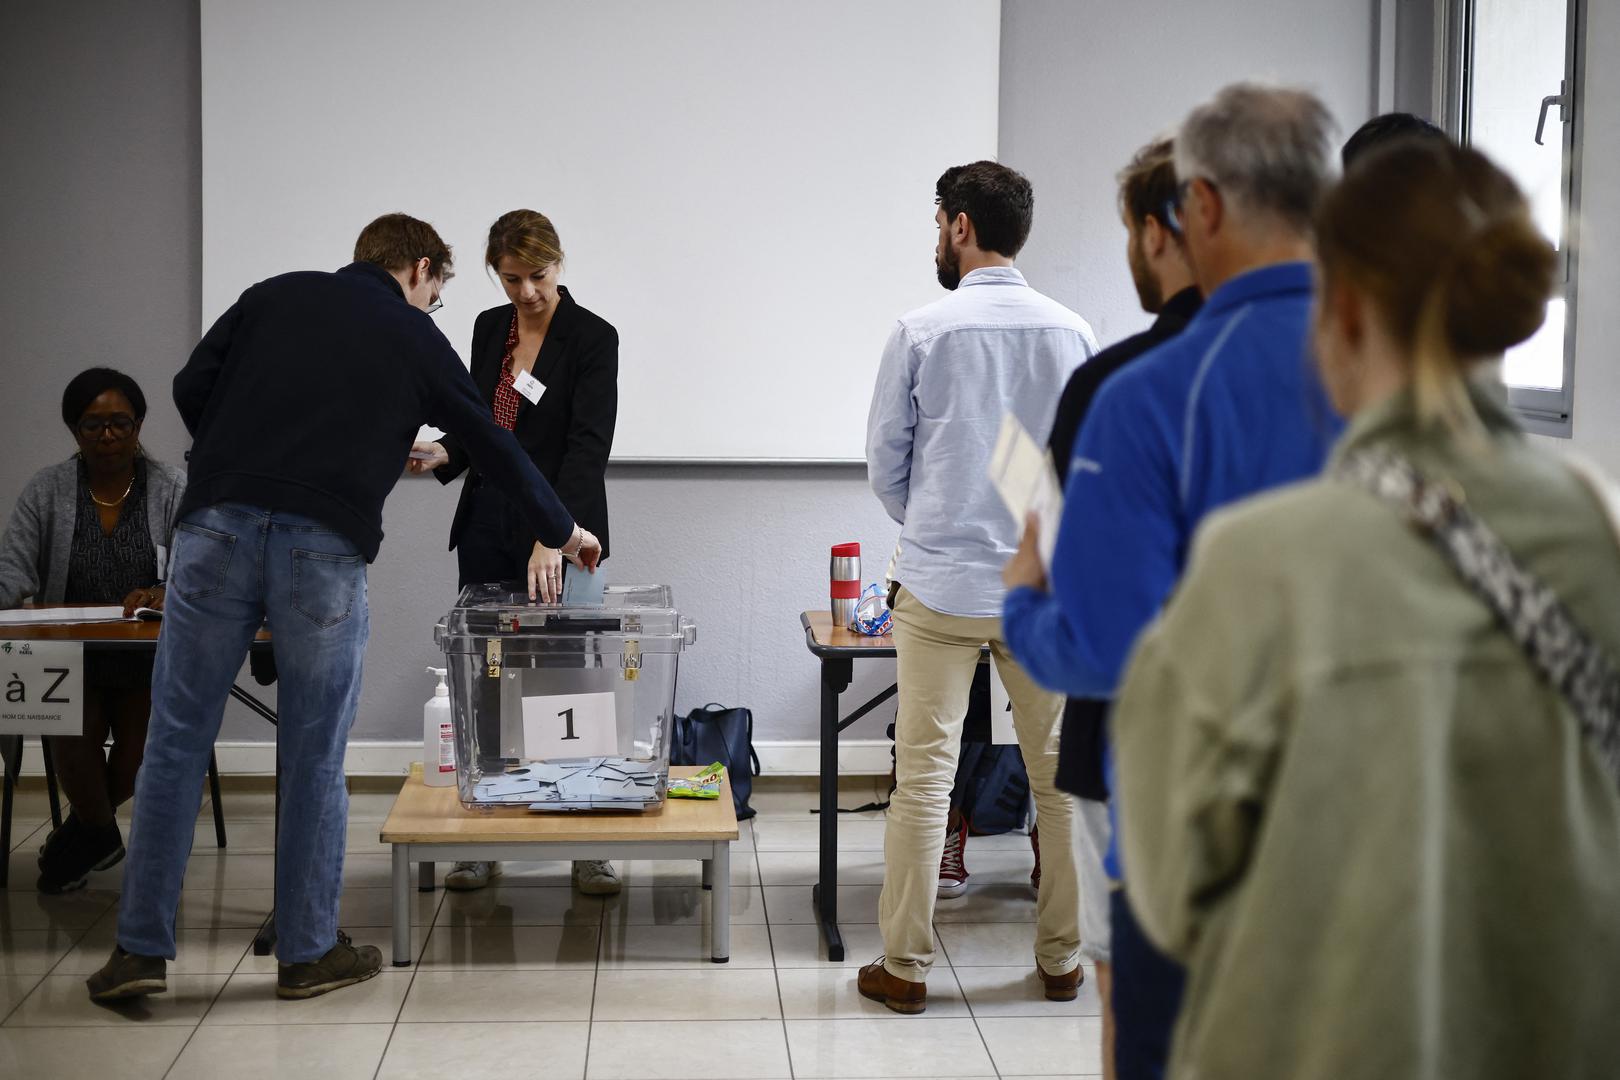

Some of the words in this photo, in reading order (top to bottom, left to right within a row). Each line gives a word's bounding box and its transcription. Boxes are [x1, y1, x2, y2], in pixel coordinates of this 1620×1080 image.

[5, 673, 26, 703] à
[41, 668, 70, 703] Z
[557, 707, 580, 742] 1
